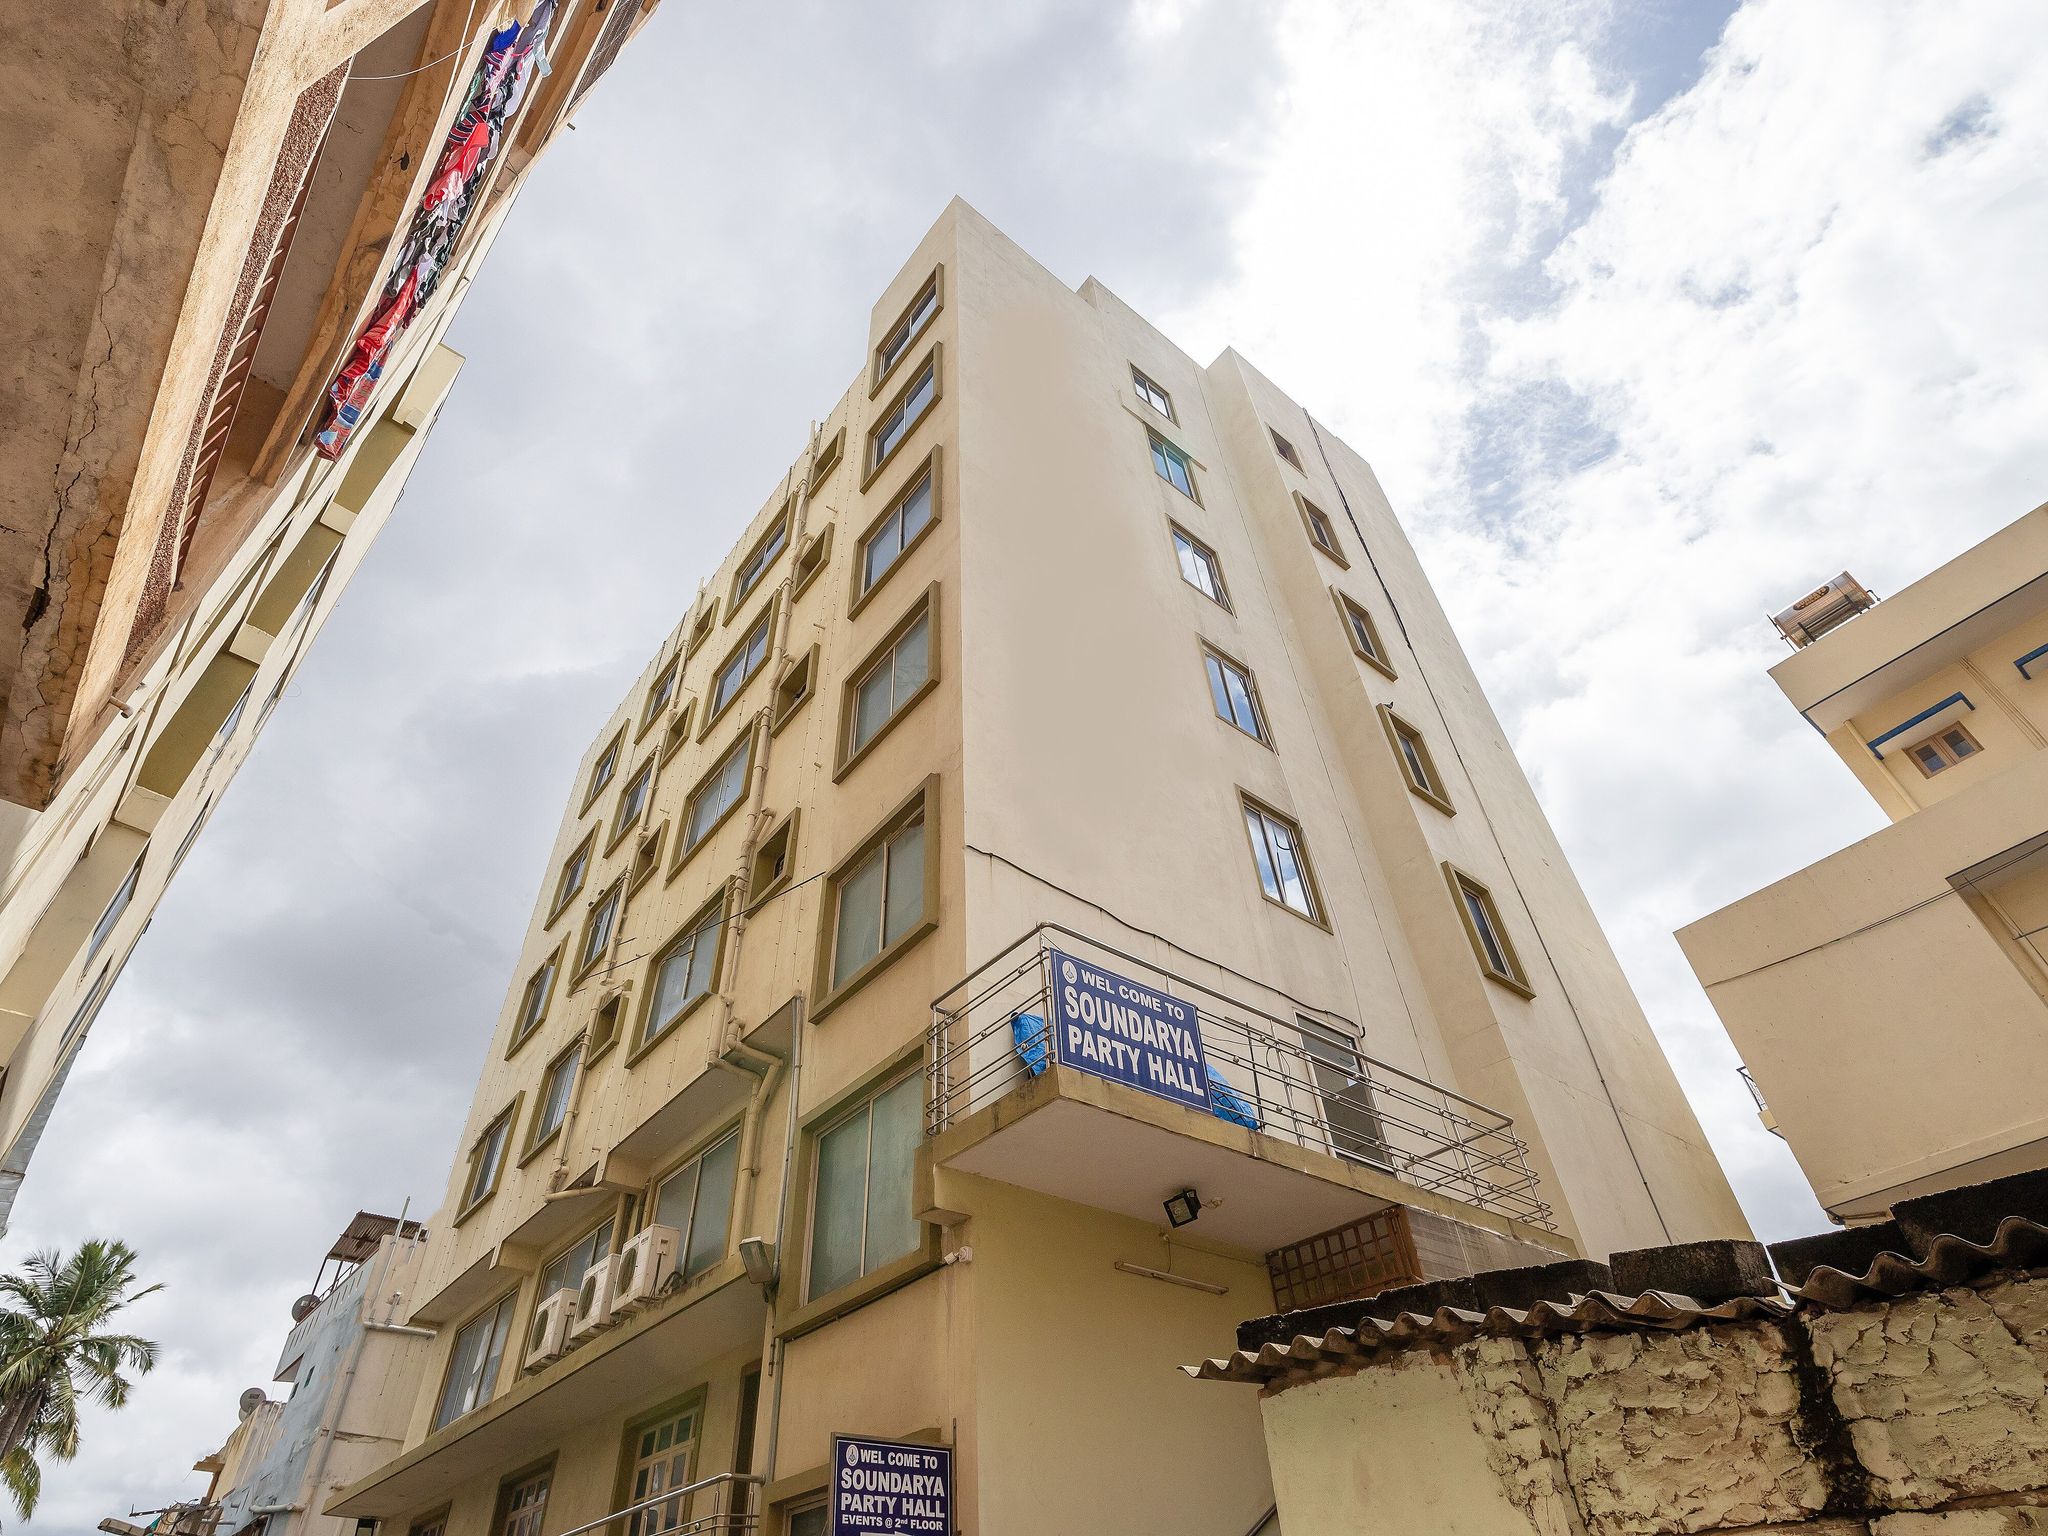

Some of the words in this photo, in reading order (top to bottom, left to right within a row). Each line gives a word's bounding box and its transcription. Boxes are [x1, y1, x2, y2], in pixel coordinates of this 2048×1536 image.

[1081, 969, 1115, 995] WEL
[1119, 985, 1161, 1012] COME
[1165, 1002, 1184, 1021] TO
[1065, 985, 1198, 1062] SOUNDARYA
[1068, 1024, 1140, 1074] PARTY
[1148, 1053, 1204, 1096] HALL
[860, 1449, 885, 1464] WEL
[888, 1452, 920, 1468] COME
[923, 1455, 938, 1469] TO
[841, 1468, 944, 1496] SOUNDARYA
[841, 1493, 897, 1514] PARTY
[902, 1498, 945, 1518] HALL
[842, 1514, 882, 1526] EVENTS
[885, 1518, 892, 1528] @
[895, 1518, 908, 1528] 2nd
[911, 1520, 943, 1530] FLOOR
